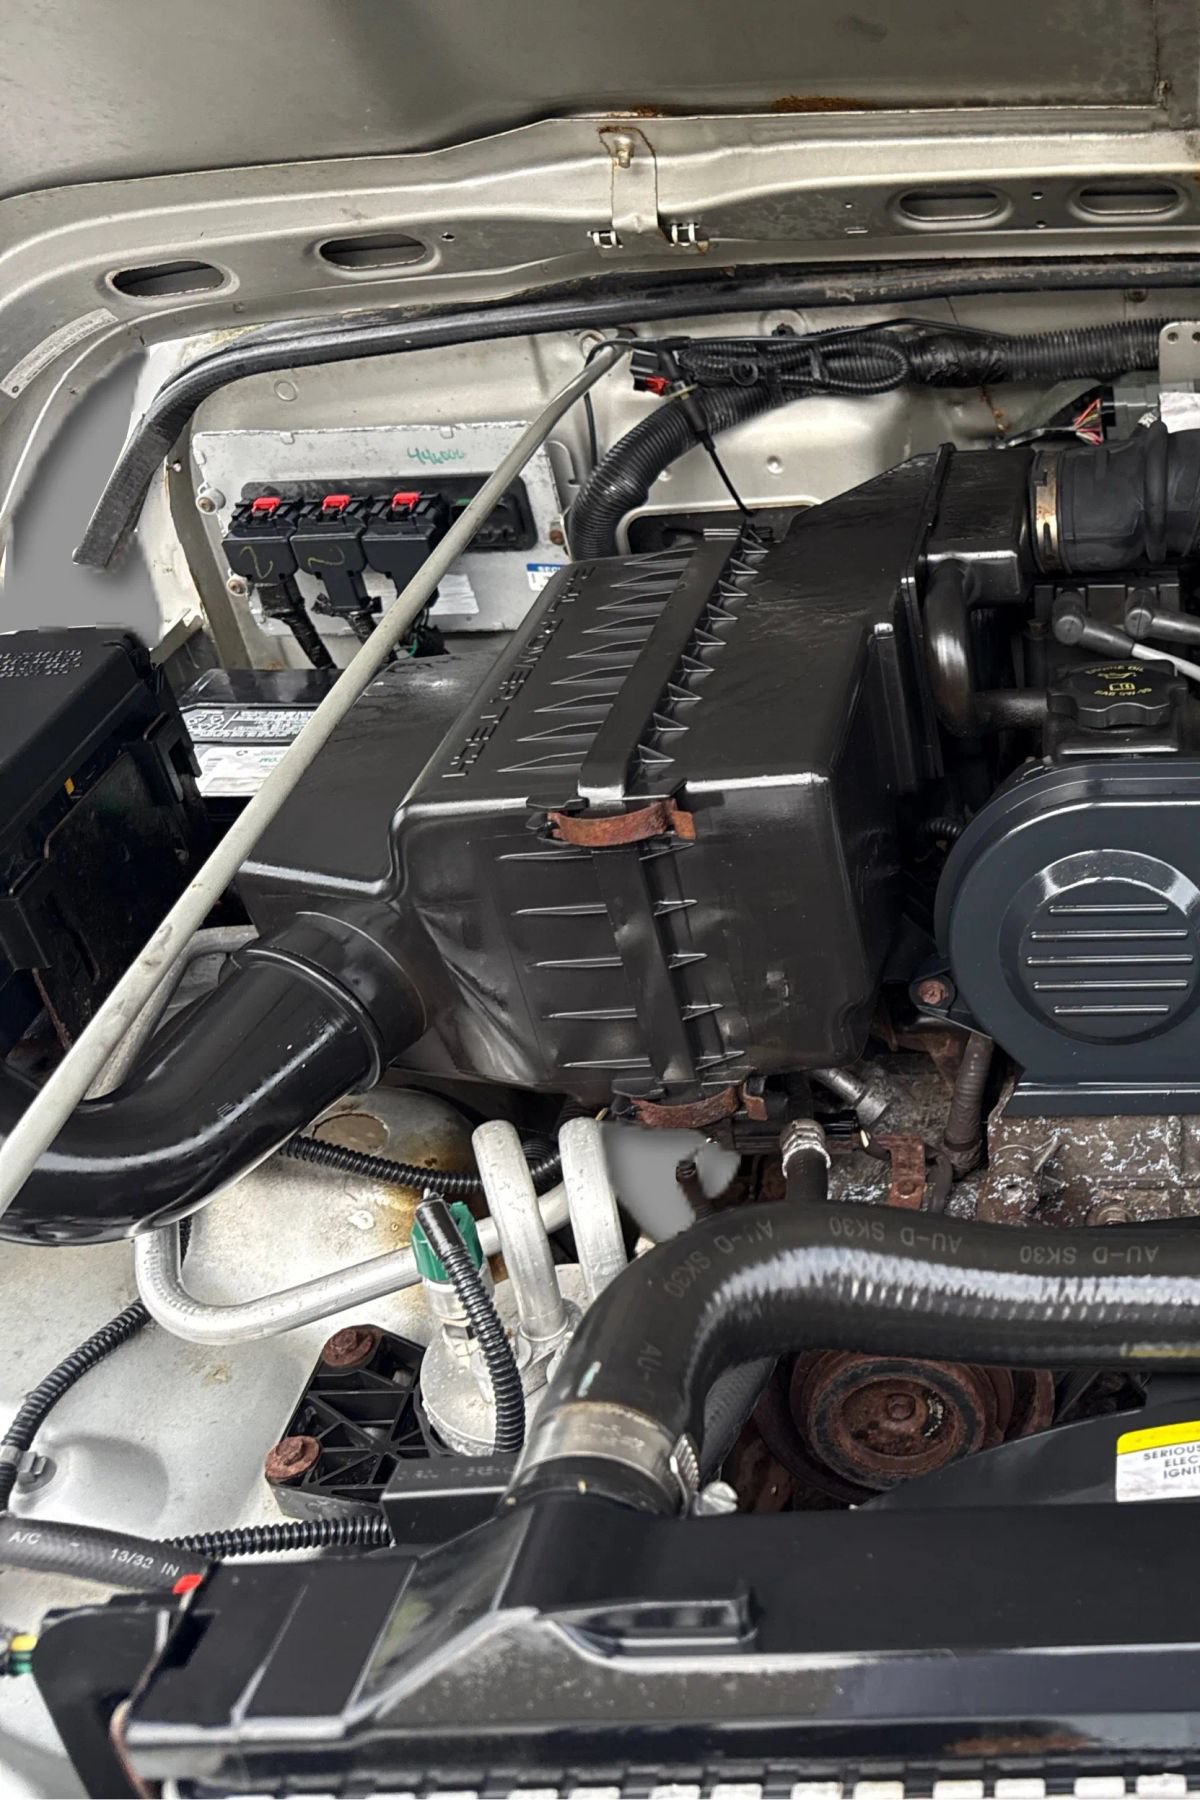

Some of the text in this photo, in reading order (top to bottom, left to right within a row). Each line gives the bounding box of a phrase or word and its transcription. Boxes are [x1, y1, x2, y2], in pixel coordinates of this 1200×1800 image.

[829, 1216, 962, 1254] AU-D SK30
[1019, 1245, 1159, 1264] AU-D SK30
[663, 1251, 711, 1298] SK30
[8, 1531, 180, 1577] A/C 13/32 IN
